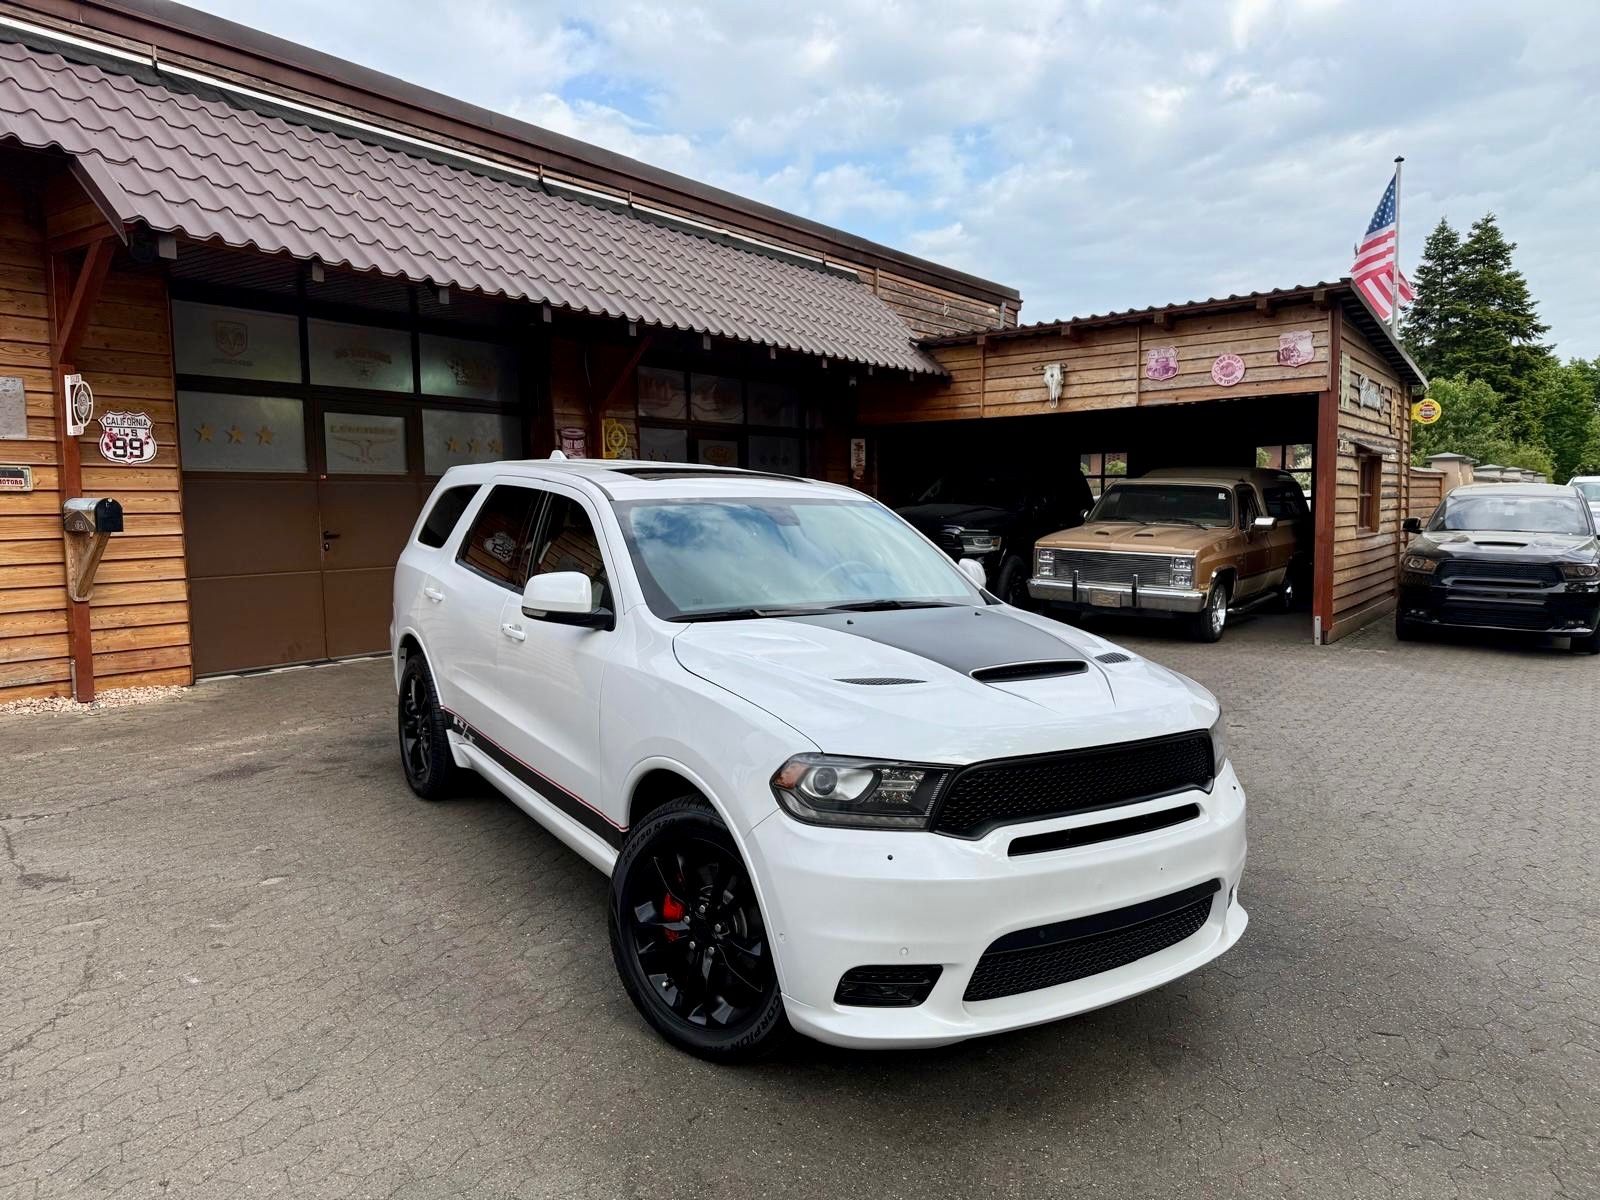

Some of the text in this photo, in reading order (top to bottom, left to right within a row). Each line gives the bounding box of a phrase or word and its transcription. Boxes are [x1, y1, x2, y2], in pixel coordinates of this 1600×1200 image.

[105, 416, 149, 427] CALIFORNIA
[112, 437, 144, 458] 99
[573, 440, 585, 449] ROD
